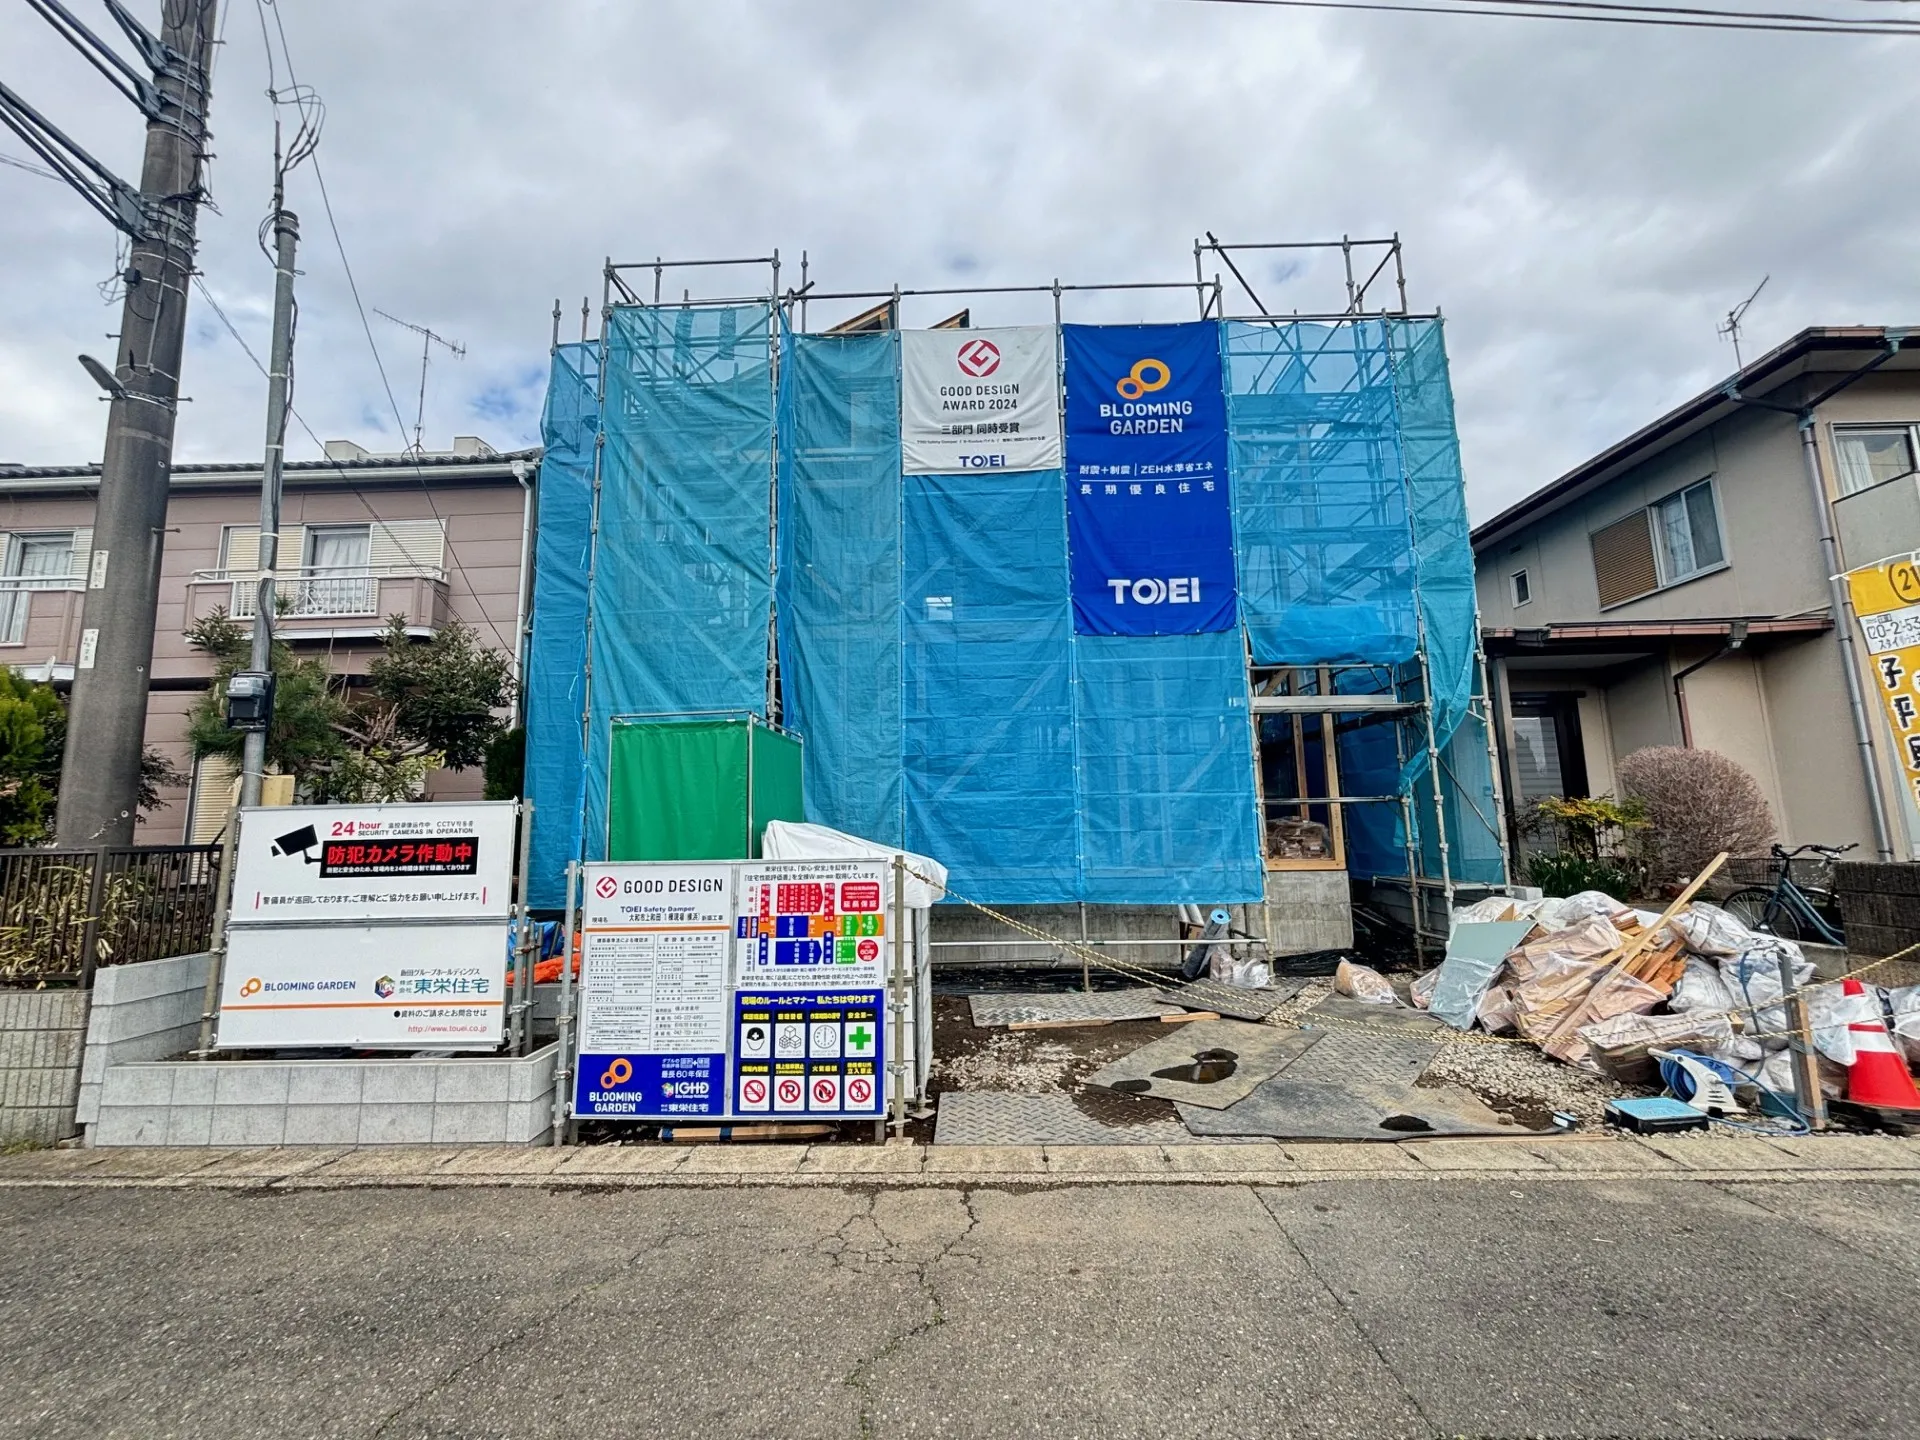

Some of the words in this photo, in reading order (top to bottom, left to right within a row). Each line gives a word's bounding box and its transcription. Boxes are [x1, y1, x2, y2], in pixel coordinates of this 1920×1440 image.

[940, 386, 972, 397] GOOD
[976, 384, 1020, 396] DESIGN
[942, 400, 985, 411] AWARD
[988, 399, 1018, 410] 2024
[1100, 401, 1192, 417] BLOOMING
[941, 424, 973, 435] 三部門
[976, 422, 1020, 434] 同時受賞
[1110, 418, 1183, 435] GARDEN
[1140, 462, 1213, 474] ZEH水準省エネ
[1081, 481, 1215, 495] 長期優良住宅
[332, 821, 355, 836] 24
[358, 821, 381, 829] hour
[327, 842, 472, 864] 防犯カメラ作動中
[624, 880, 663, 893] GOOD
[668, 879, 723, 892] DESIGN
[265, 982, 315, 991] BLOOMING
[317, 980, 356, 990] GARDEN
[414, 978, 489, 994] 東栄住宅
[408, 1024, 487, 1033] http://www.touei.co.jp
[589, 1092, 642, 1102] BLOOMING
[594, 1103, 636, 1112] GARDEN
